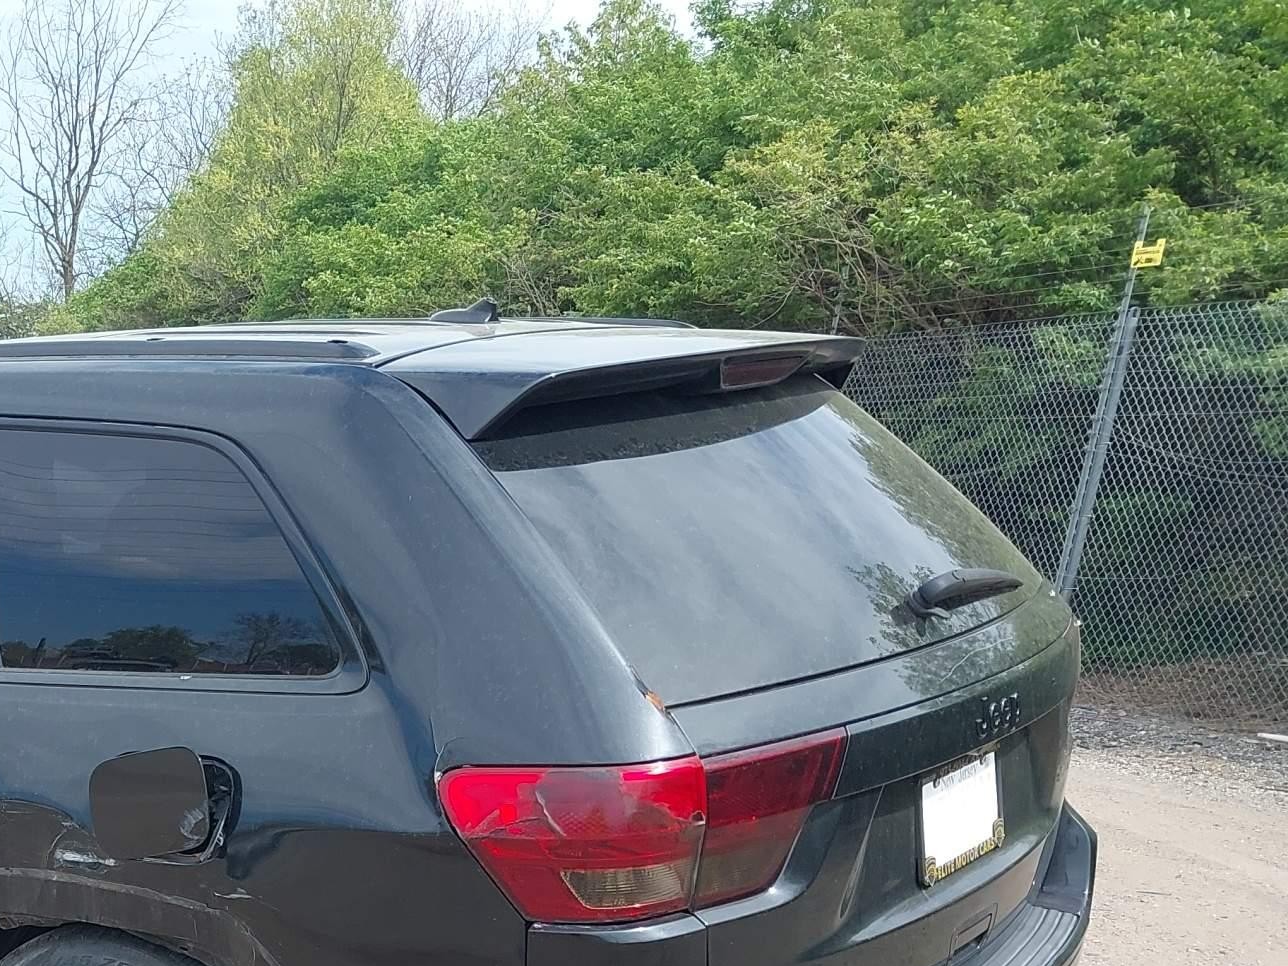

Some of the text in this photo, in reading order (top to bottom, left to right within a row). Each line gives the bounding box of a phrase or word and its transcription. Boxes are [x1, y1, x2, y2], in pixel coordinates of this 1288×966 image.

[936, 836, 996, 881] ELITE MOTOR CARS
